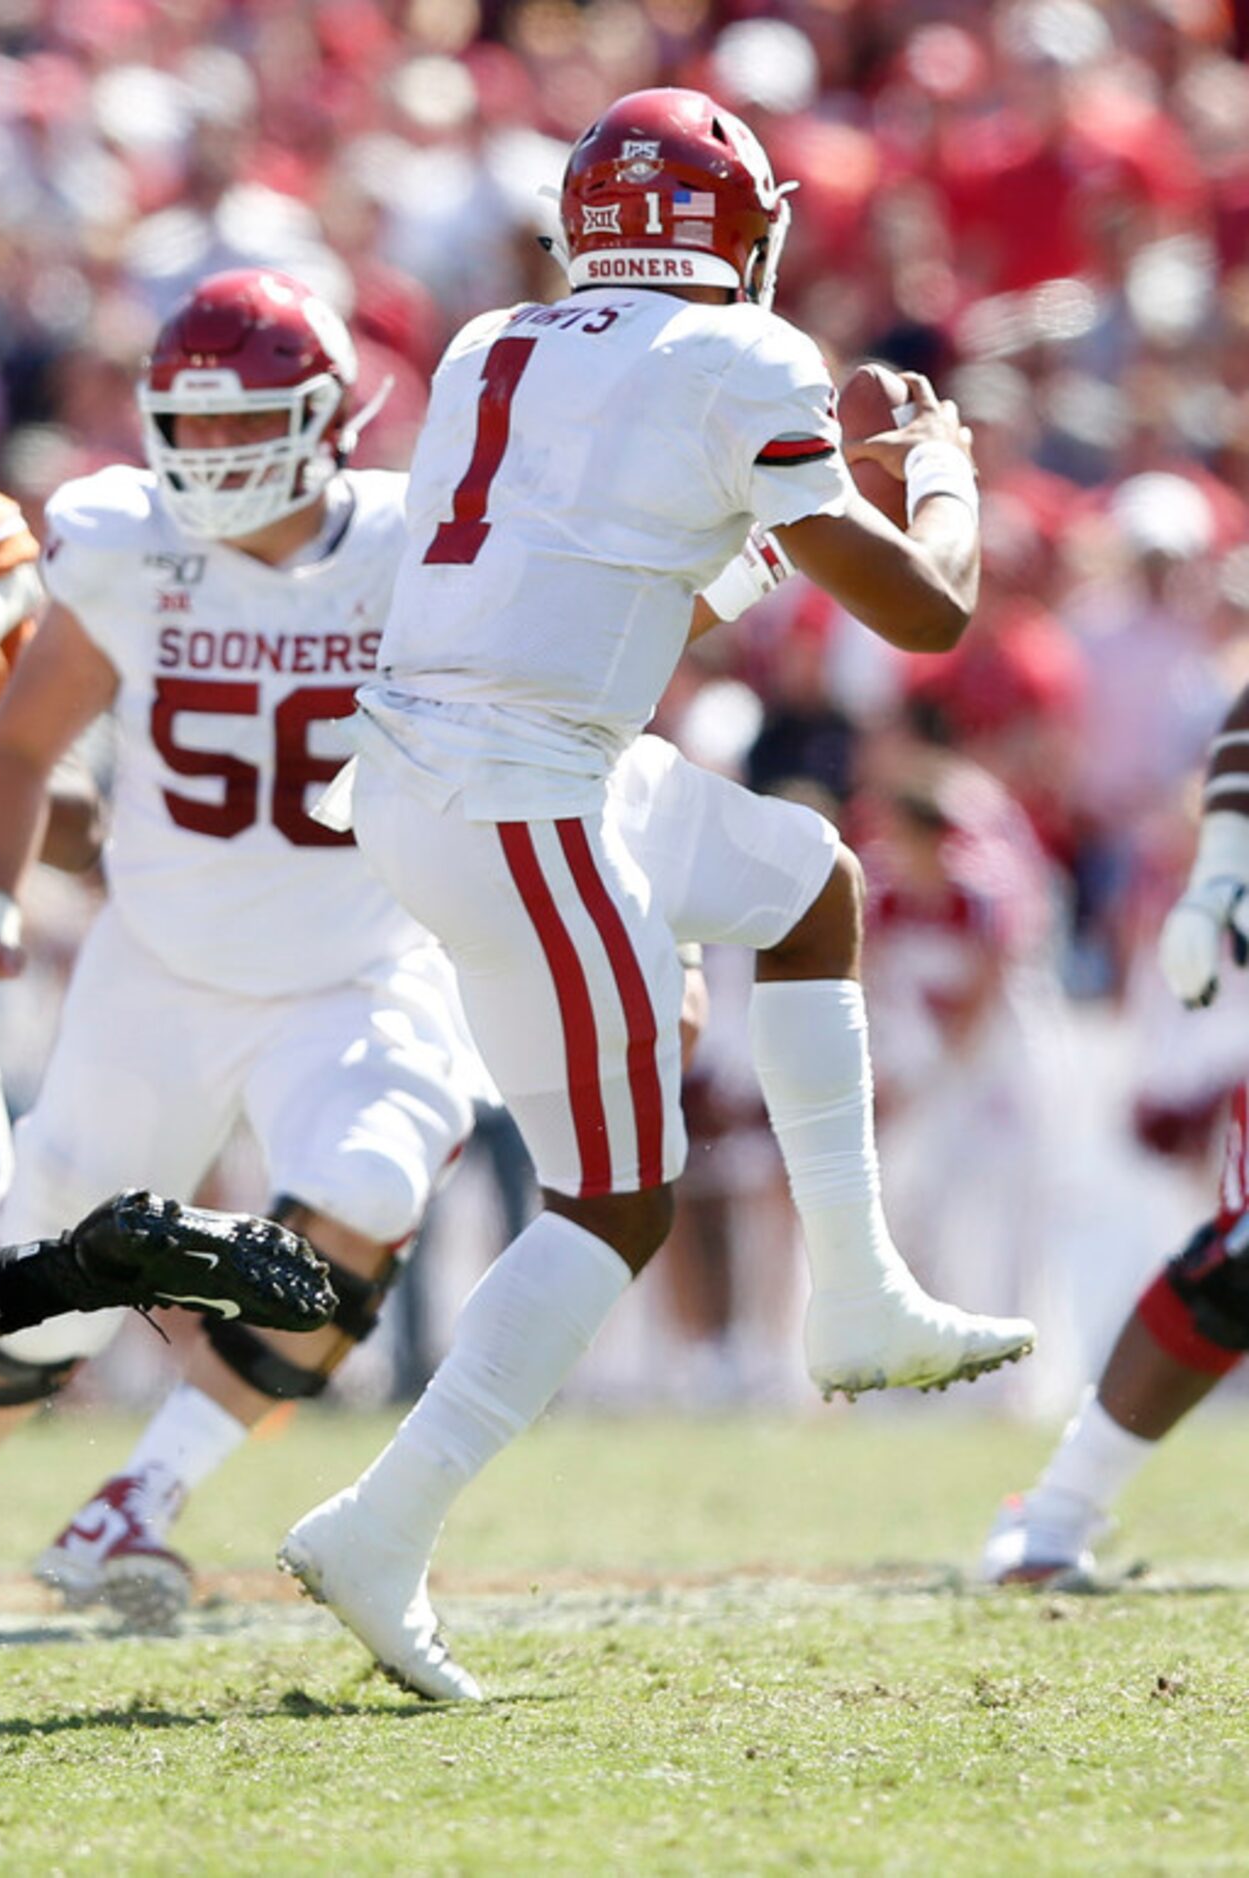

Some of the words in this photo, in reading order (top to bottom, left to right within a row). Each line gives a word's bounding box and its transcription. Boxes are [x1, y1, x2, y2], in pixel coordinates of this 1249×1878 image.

[645, 193, 663, 233] 1
[587, 258, 695, 278] SOONERS
[423, 336, 538, 564] 1
[158, 628, 384, 672] SOONERS
